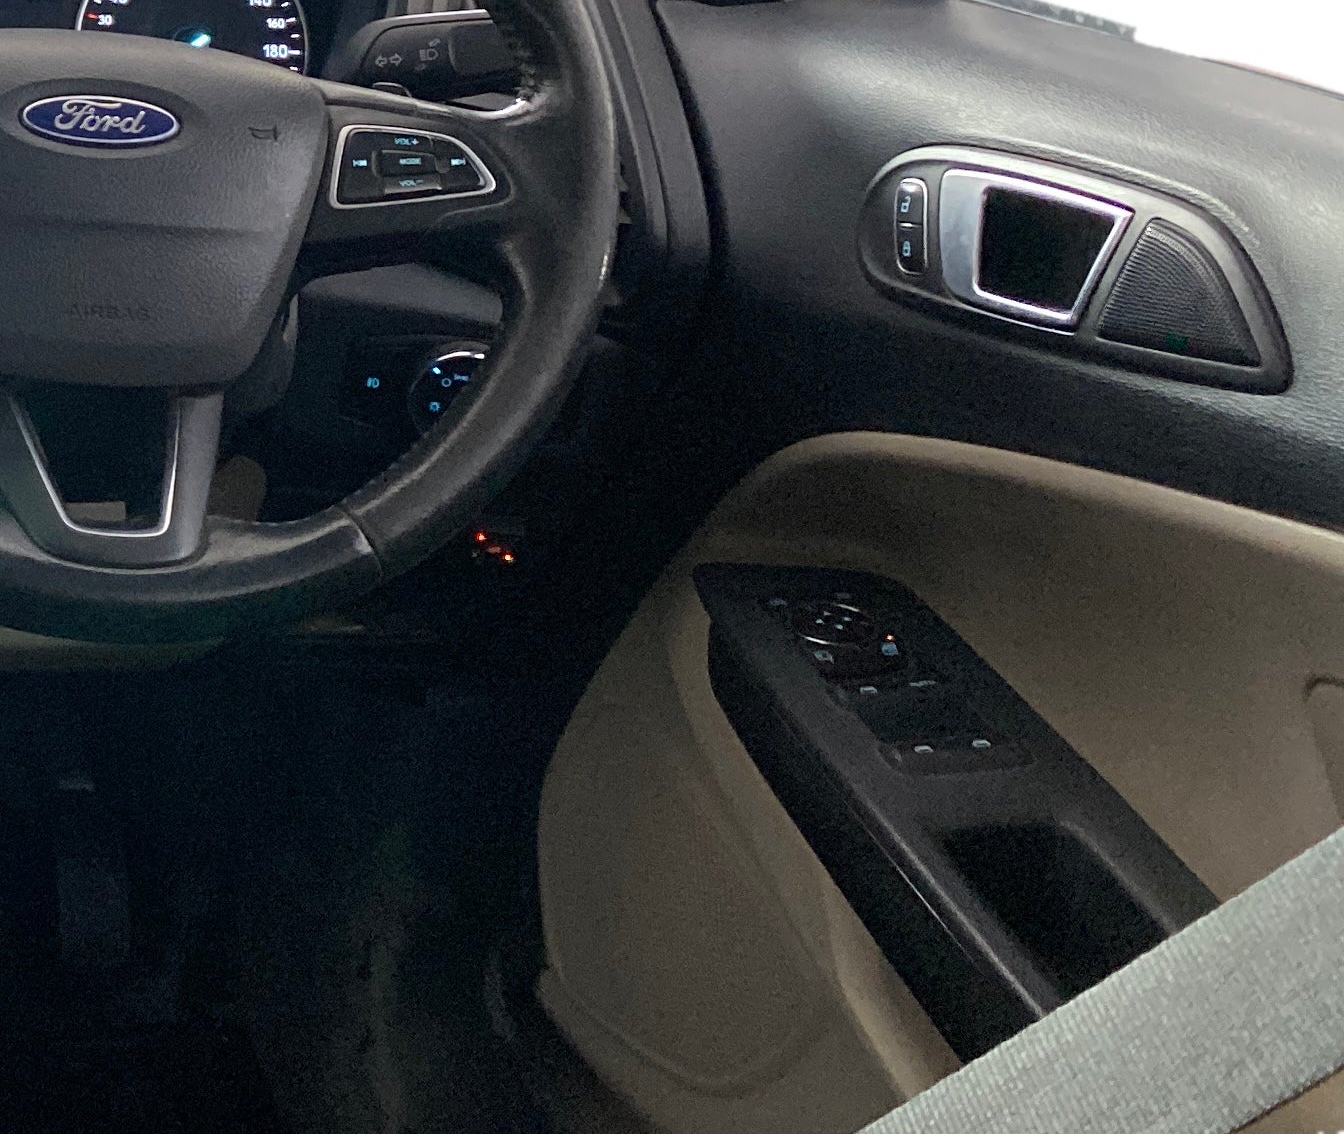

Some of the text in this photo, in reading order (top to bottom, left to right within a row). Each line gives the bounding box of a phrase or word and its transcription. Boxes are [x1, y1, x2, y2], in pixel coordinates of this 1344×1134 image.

[97, 14, 113, 26] 30
[266, 17, 286, 30] 160
[262, 44, 289, 59] 180
[53, 98, 146, 134] Ford
